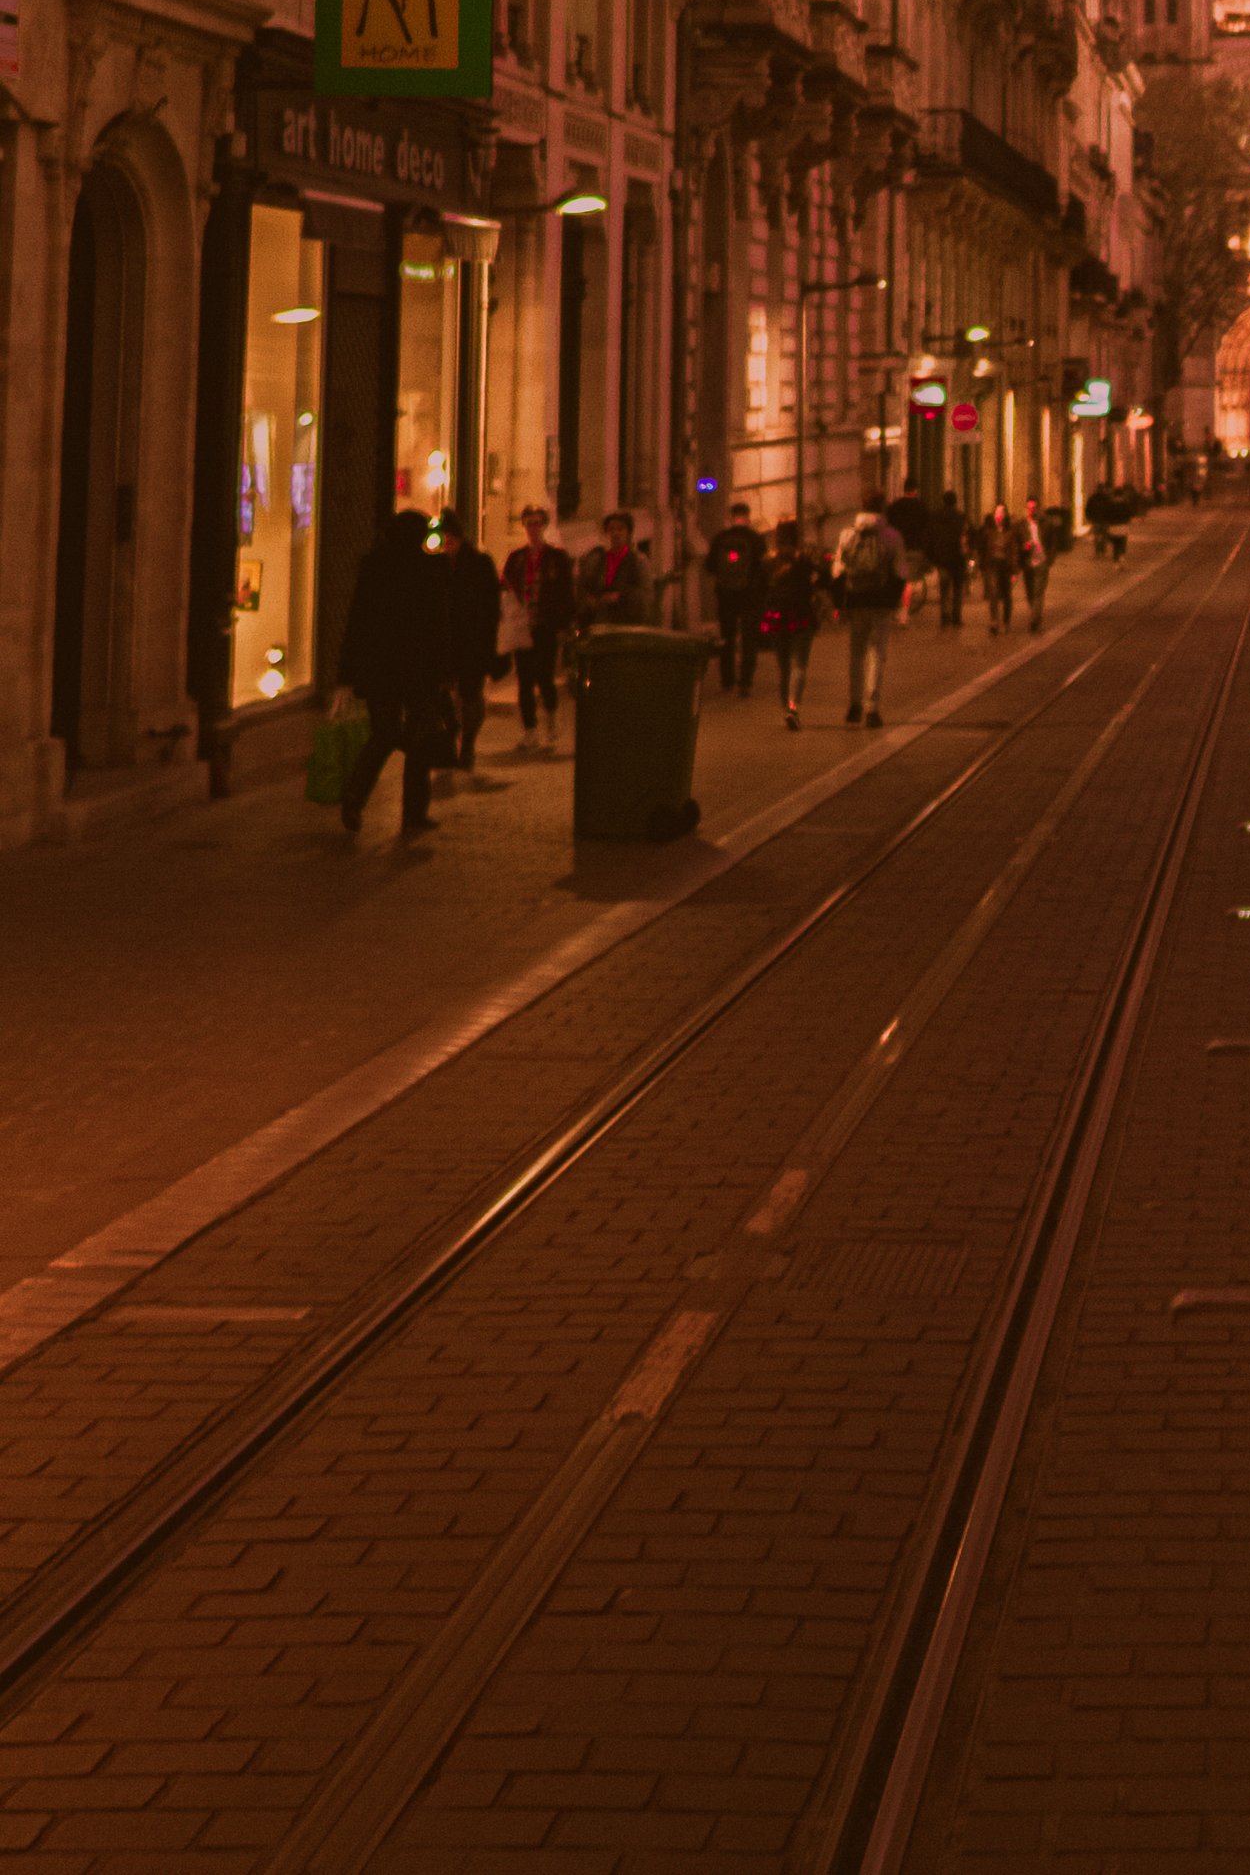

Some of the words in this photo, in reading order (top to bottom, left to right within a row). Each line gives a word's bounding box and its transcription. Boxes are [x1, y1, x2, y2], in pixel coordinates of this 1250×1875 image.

[360, 45, 437, 63] HOME
[282, 102, 318, 162] art
[329, 108, 386, 176] home
[396, 127, 446, 191] deco
